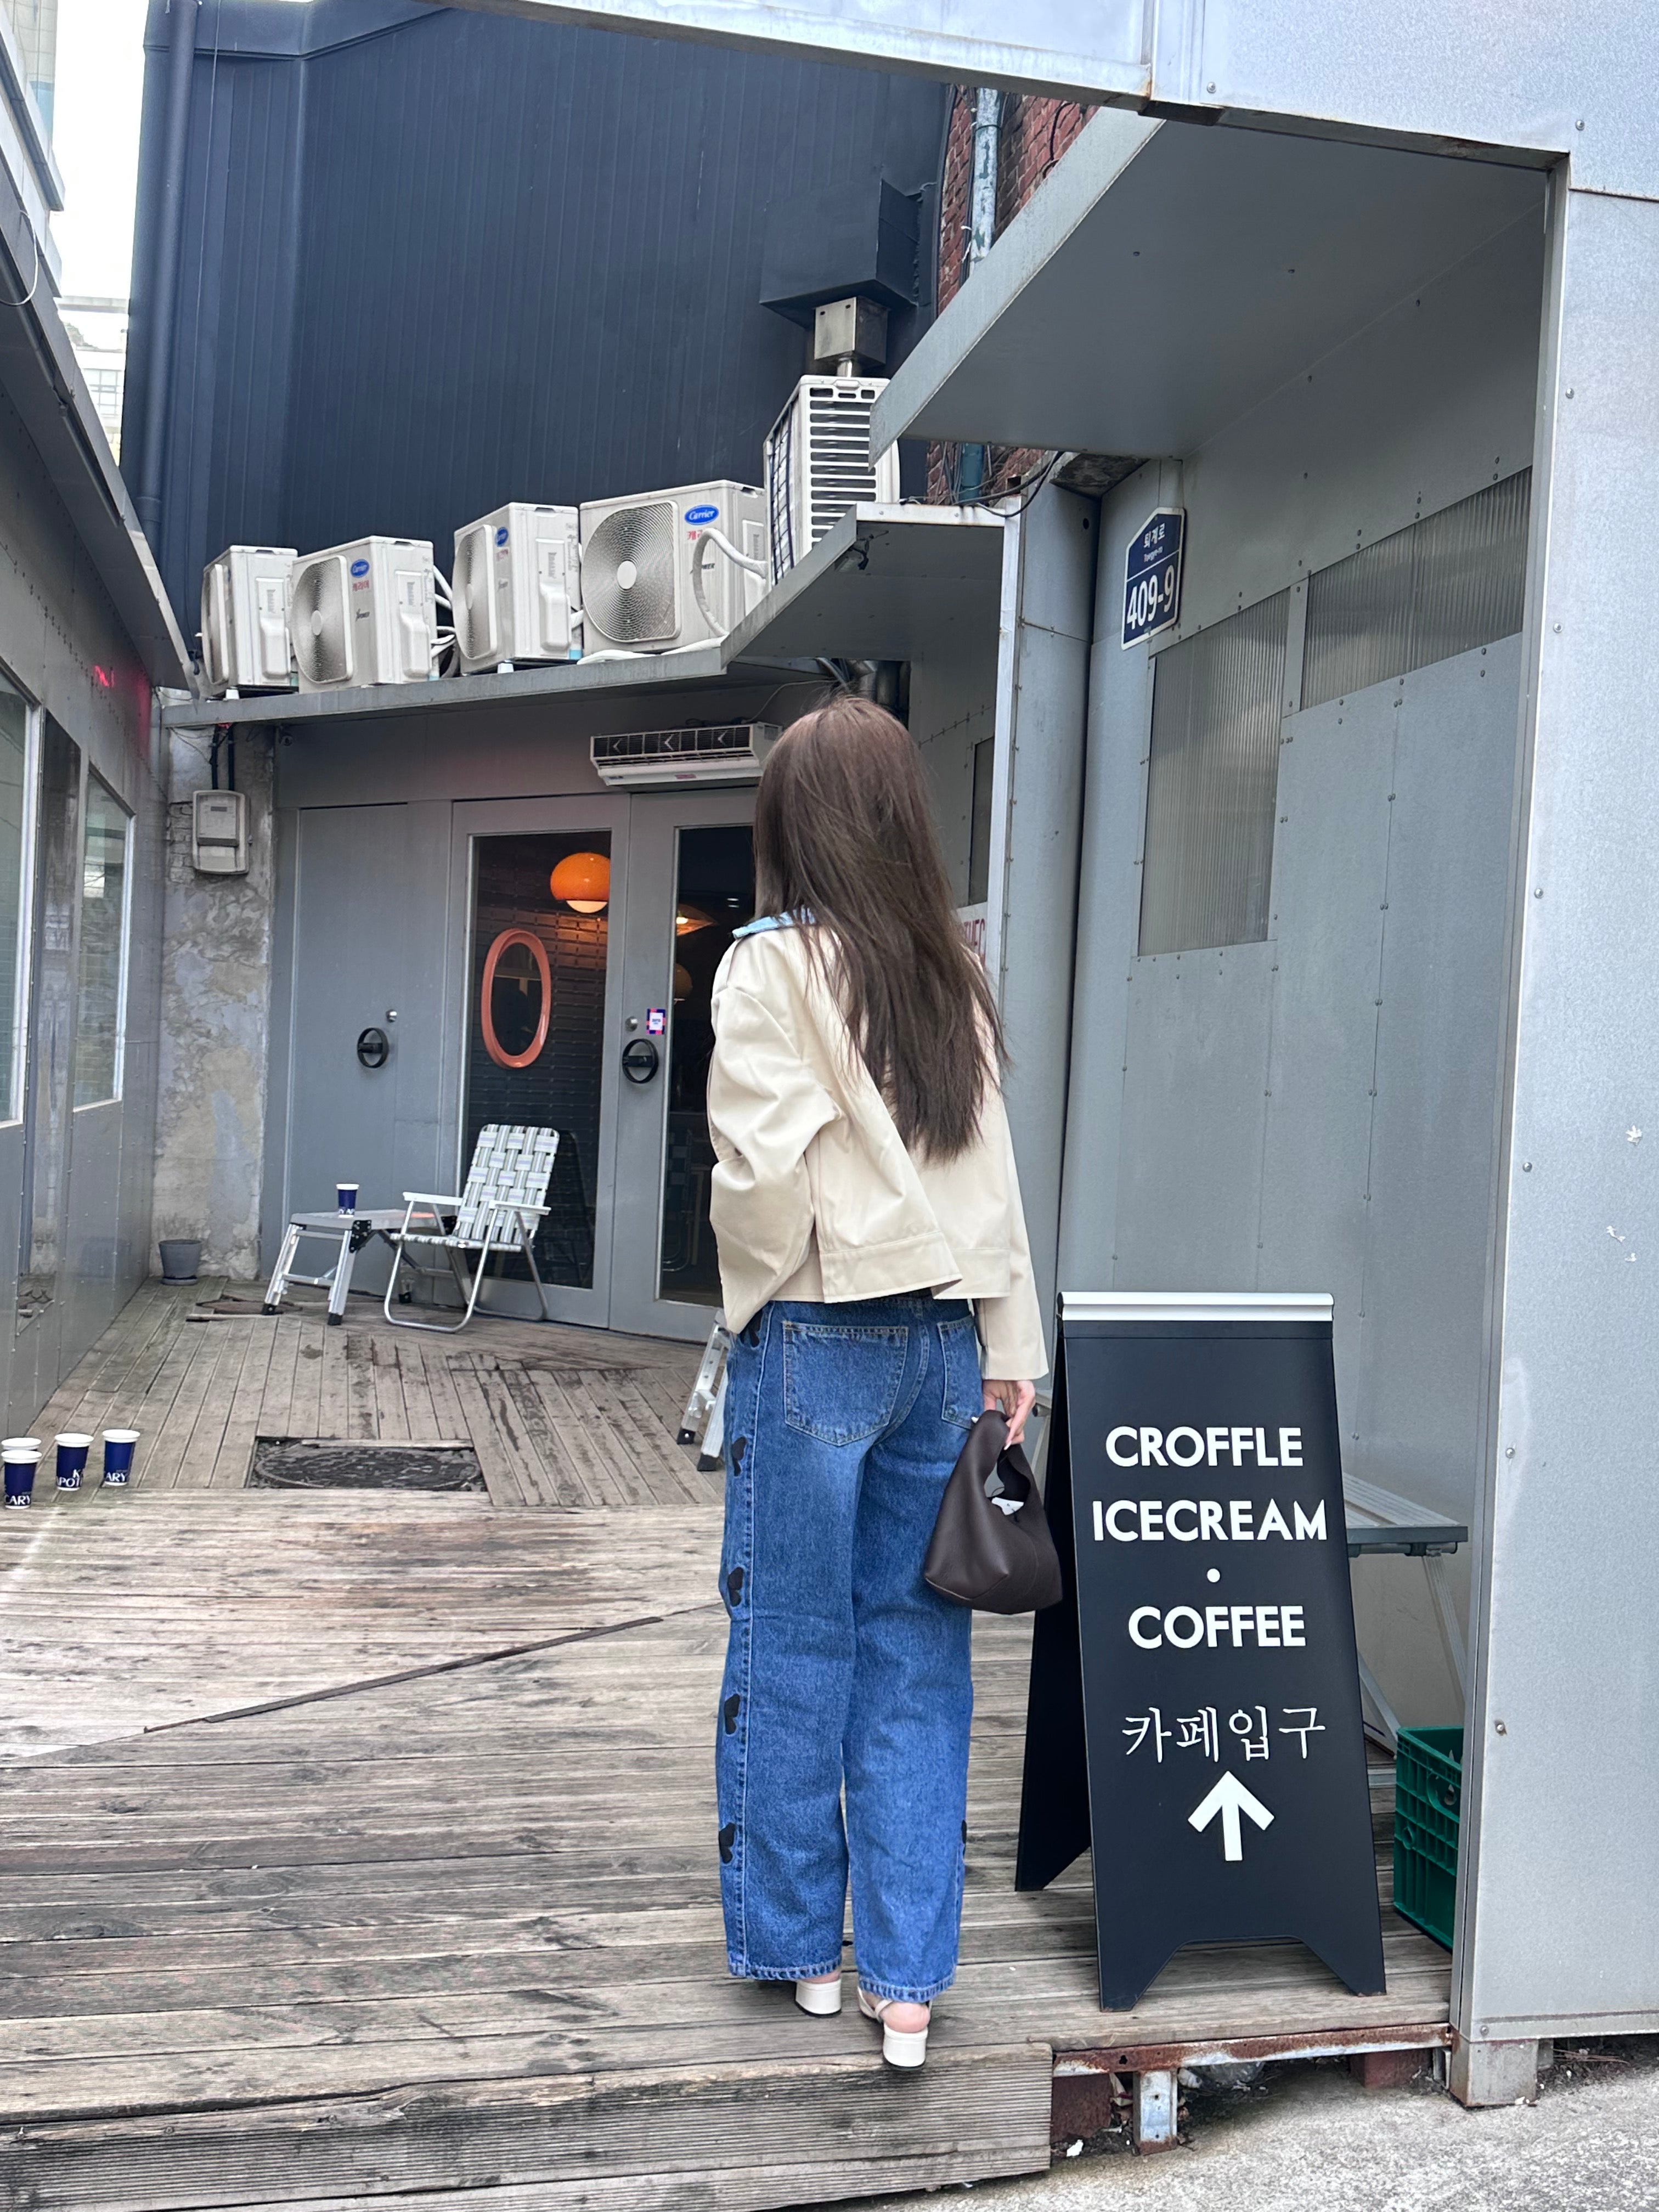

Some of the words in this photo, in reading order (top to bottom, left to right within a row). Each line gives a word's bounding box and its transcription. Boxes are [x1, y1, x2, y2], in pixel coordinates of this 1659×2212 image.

[689, 510, 715, 521] Carrier
[1126, 565, 1175, 630] 409-9
[1105, 1426, 1304, 1467] CROFFLE
[1092, 1499, 1327, 1541] ICECREAM
[1128, 1605, 1306, 1649] COFFEE
[1122, 1705, 1326, 1763] 카페입구
